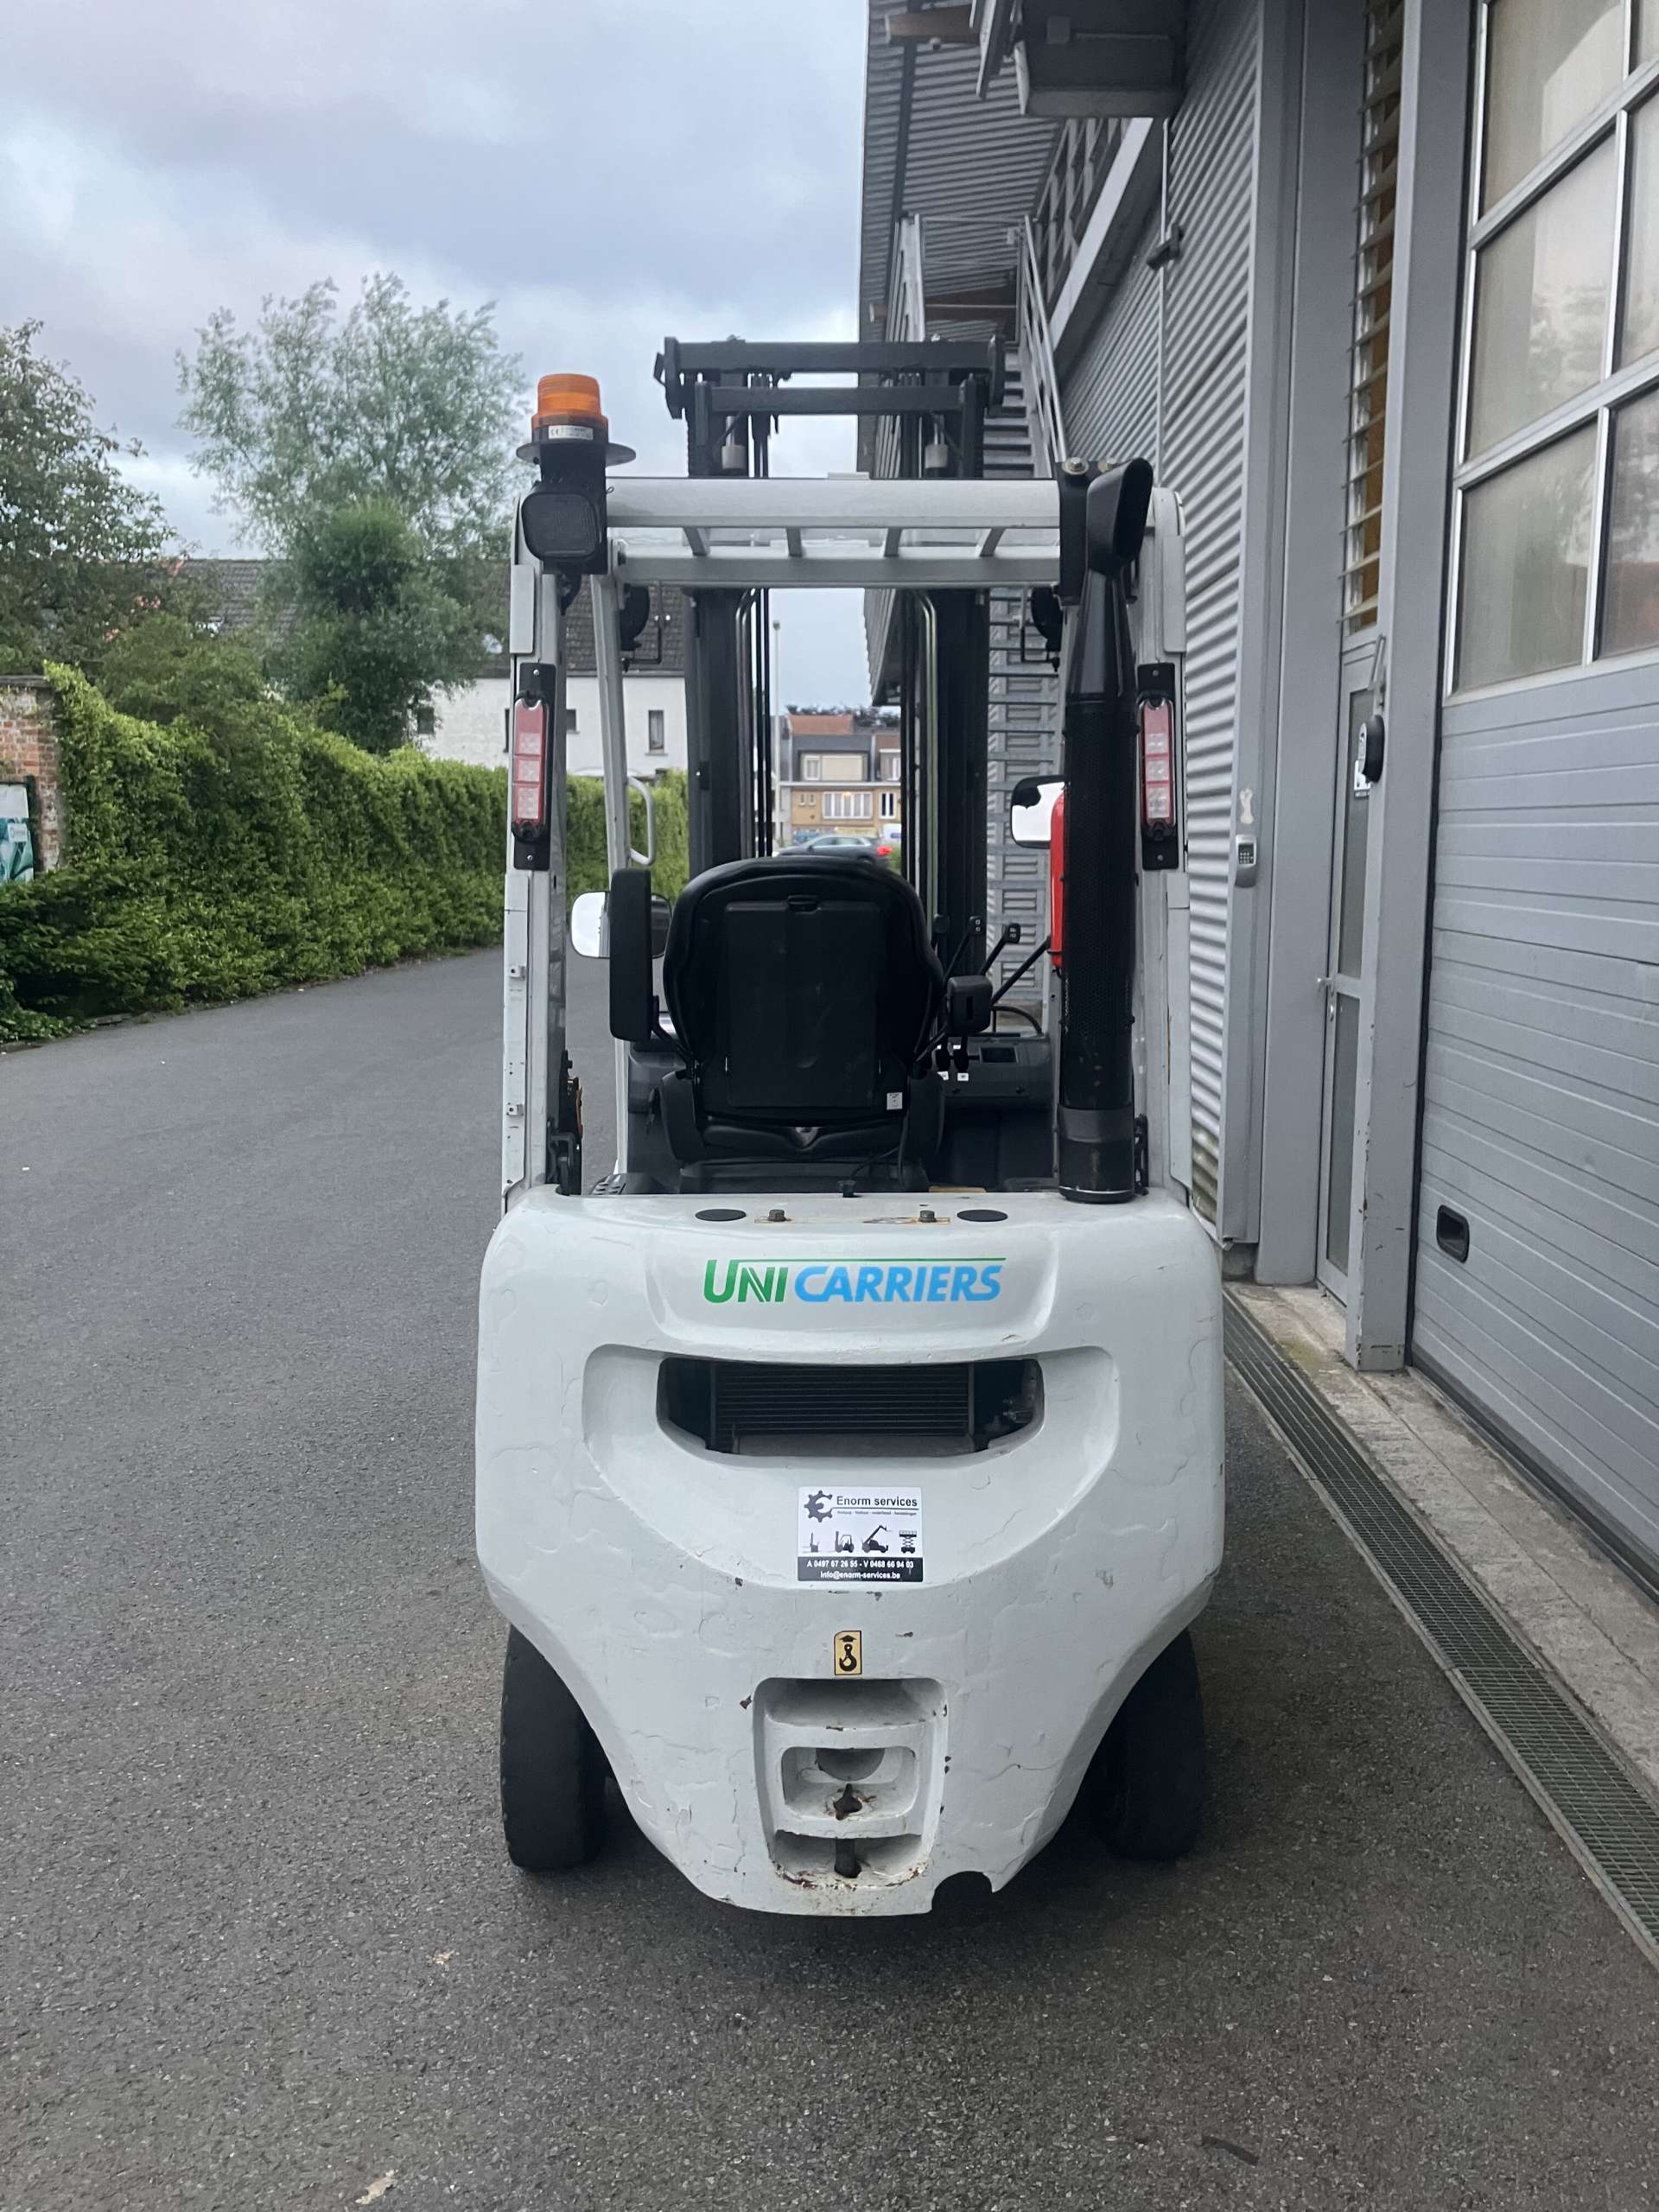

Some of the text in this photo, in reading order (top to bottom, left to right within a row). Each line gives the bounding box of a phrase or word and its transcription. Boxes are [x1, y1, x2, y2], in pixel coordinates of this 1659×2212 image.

[836, 1496, 918, 1507] Enorm services
[806, 1560, 813, 1568] A
[863, 1560, 869, 1568] V
